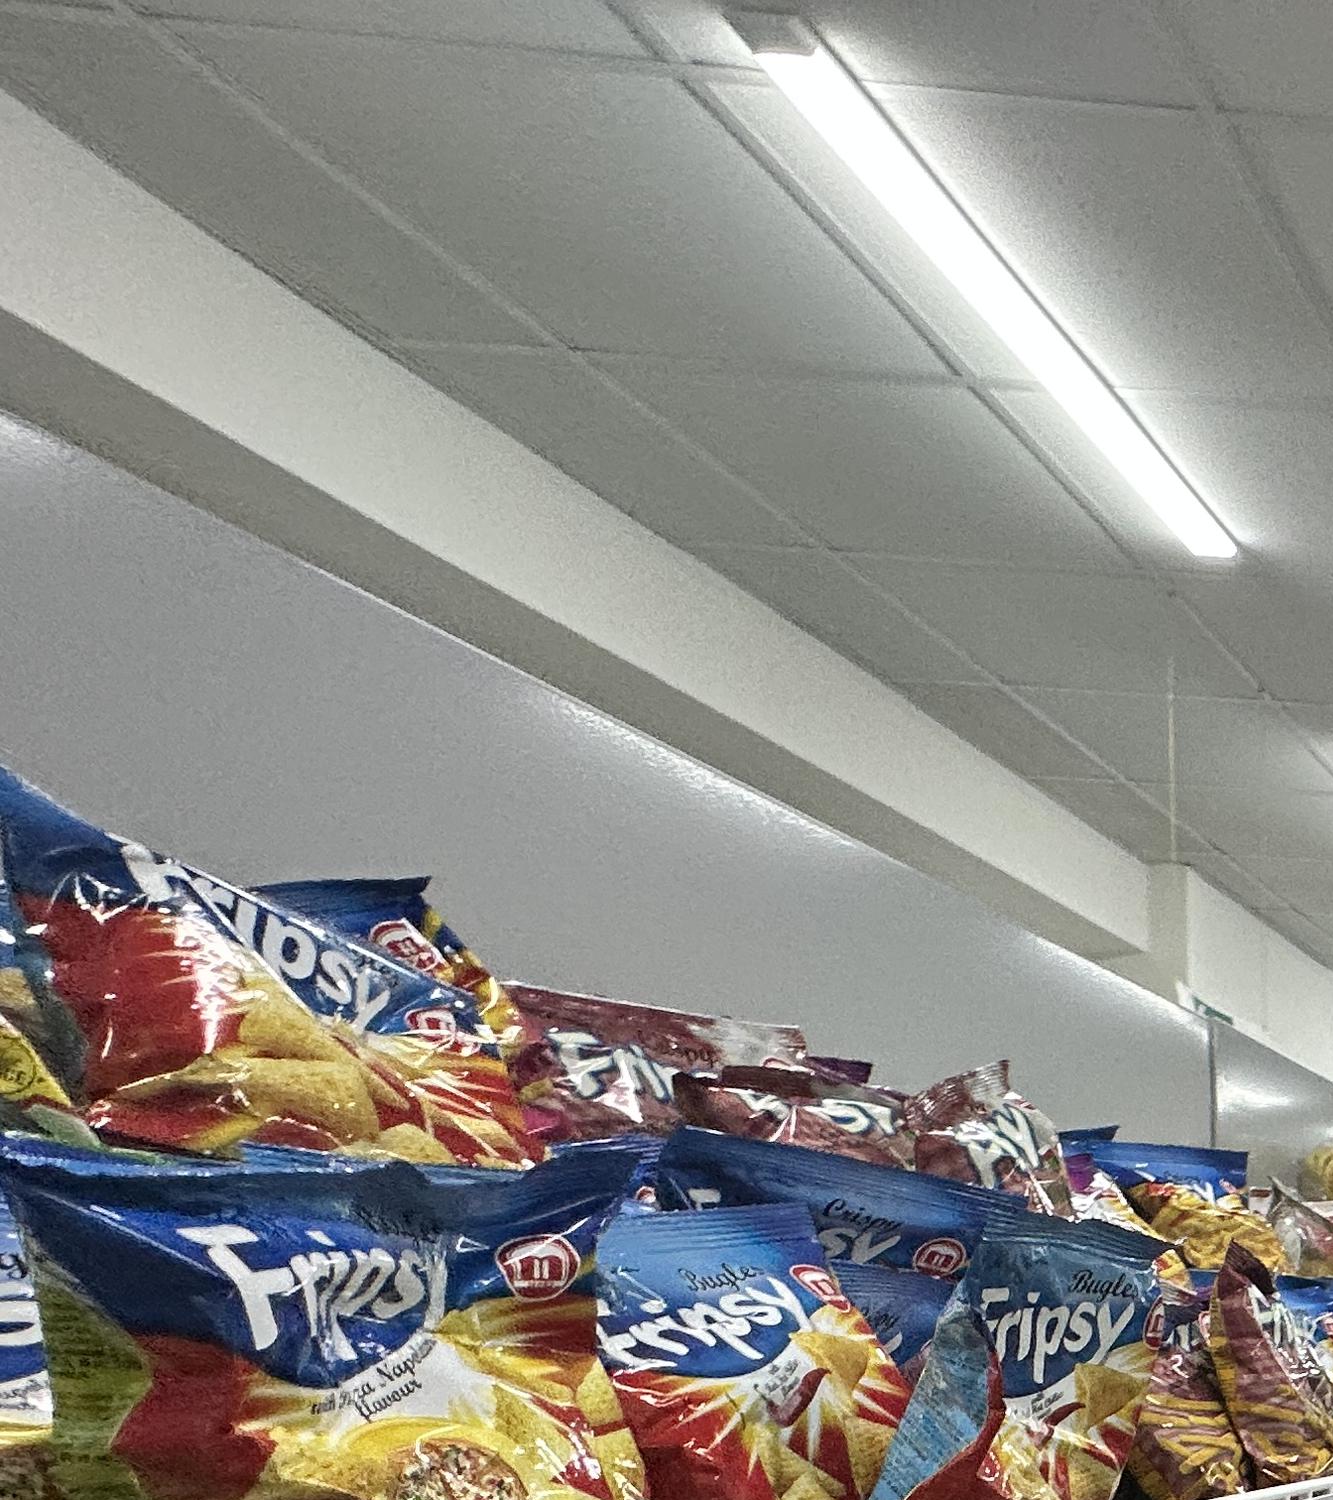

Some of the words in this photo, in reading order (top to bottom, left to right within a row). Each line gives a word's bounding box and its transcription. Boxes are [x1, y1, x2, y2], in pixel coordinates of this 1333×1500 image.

[1069, 1268, 1140, 1301] Bugles
[981, 1287, 1136, 1384] Fripsy
[354, 1378, 423, 1423] flavour
